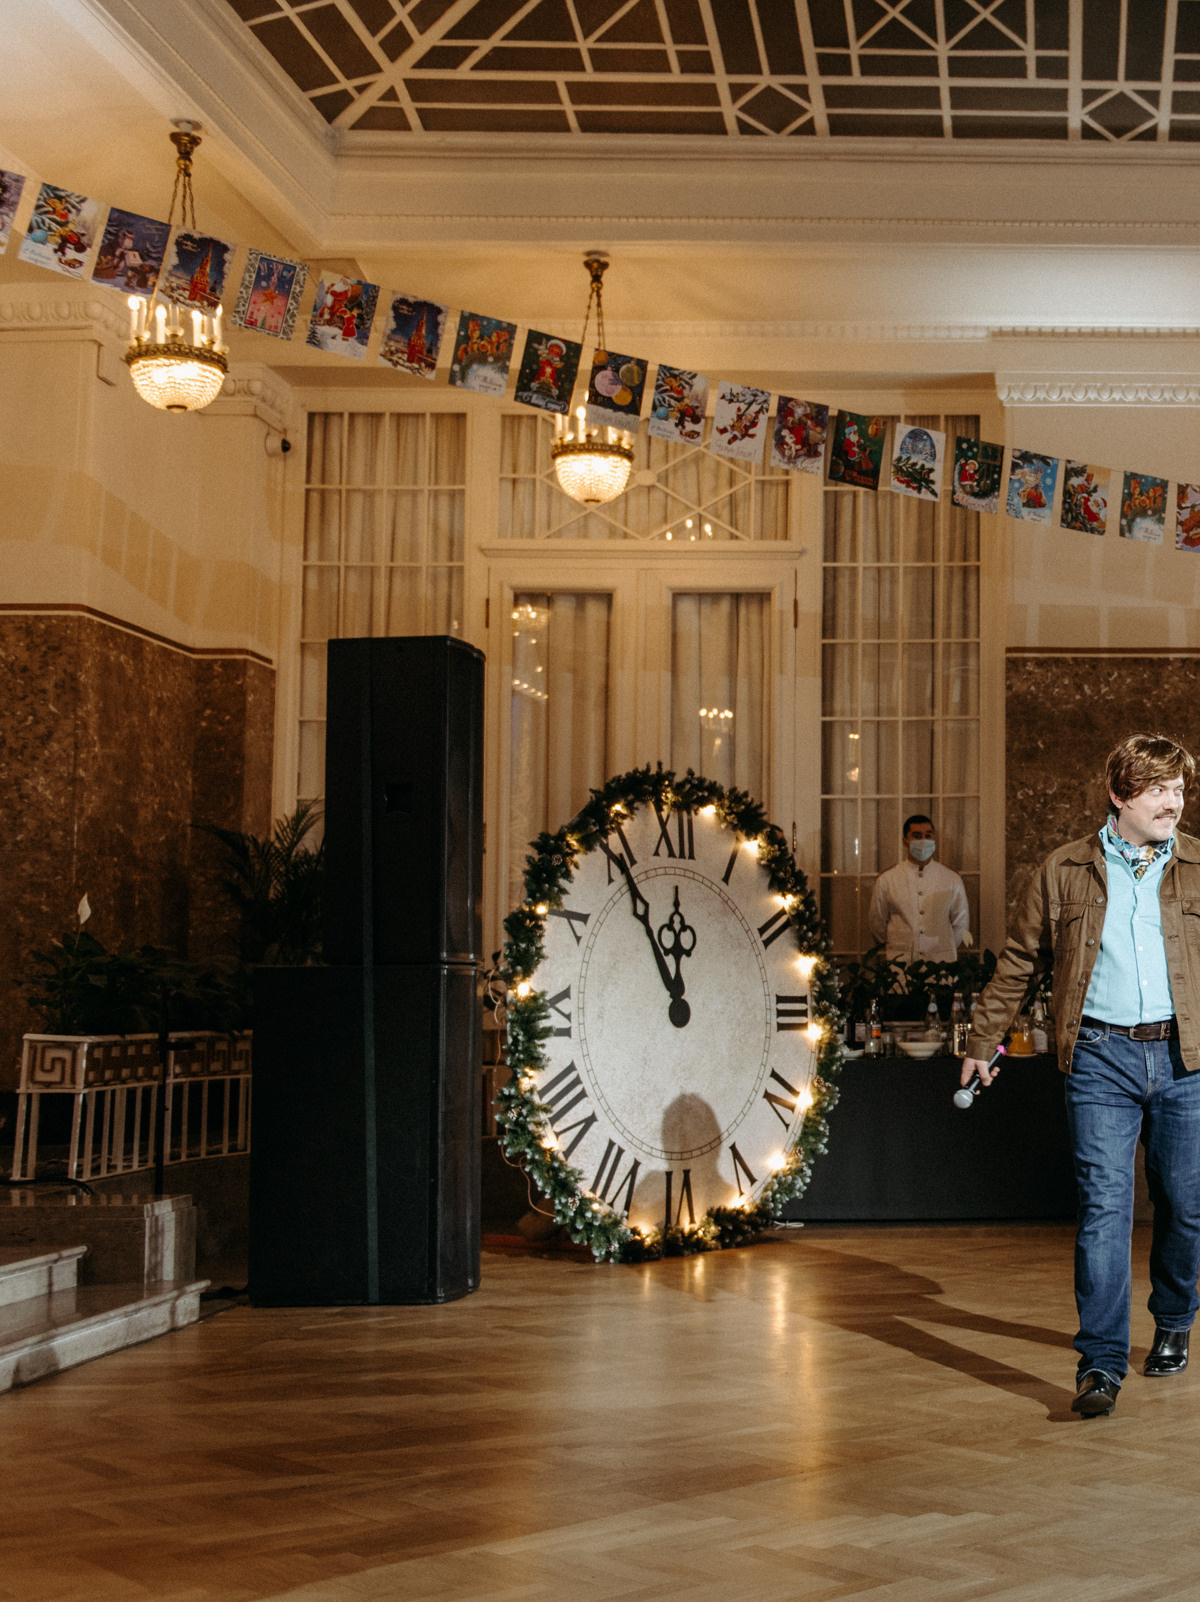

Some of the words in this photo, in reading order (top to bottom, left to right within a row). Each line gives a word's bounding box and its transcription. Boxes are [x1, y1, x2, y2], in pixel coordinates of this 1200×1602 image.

[651, 801, 696, 861] XII
[775, 993, 809, 1032] III
[763, 1067, 803, 1132] IV
[589, 1137, 643, 1219] VII
[664, 1168, 697, 1229] VI
[729, 1141, 758, 1198] V
